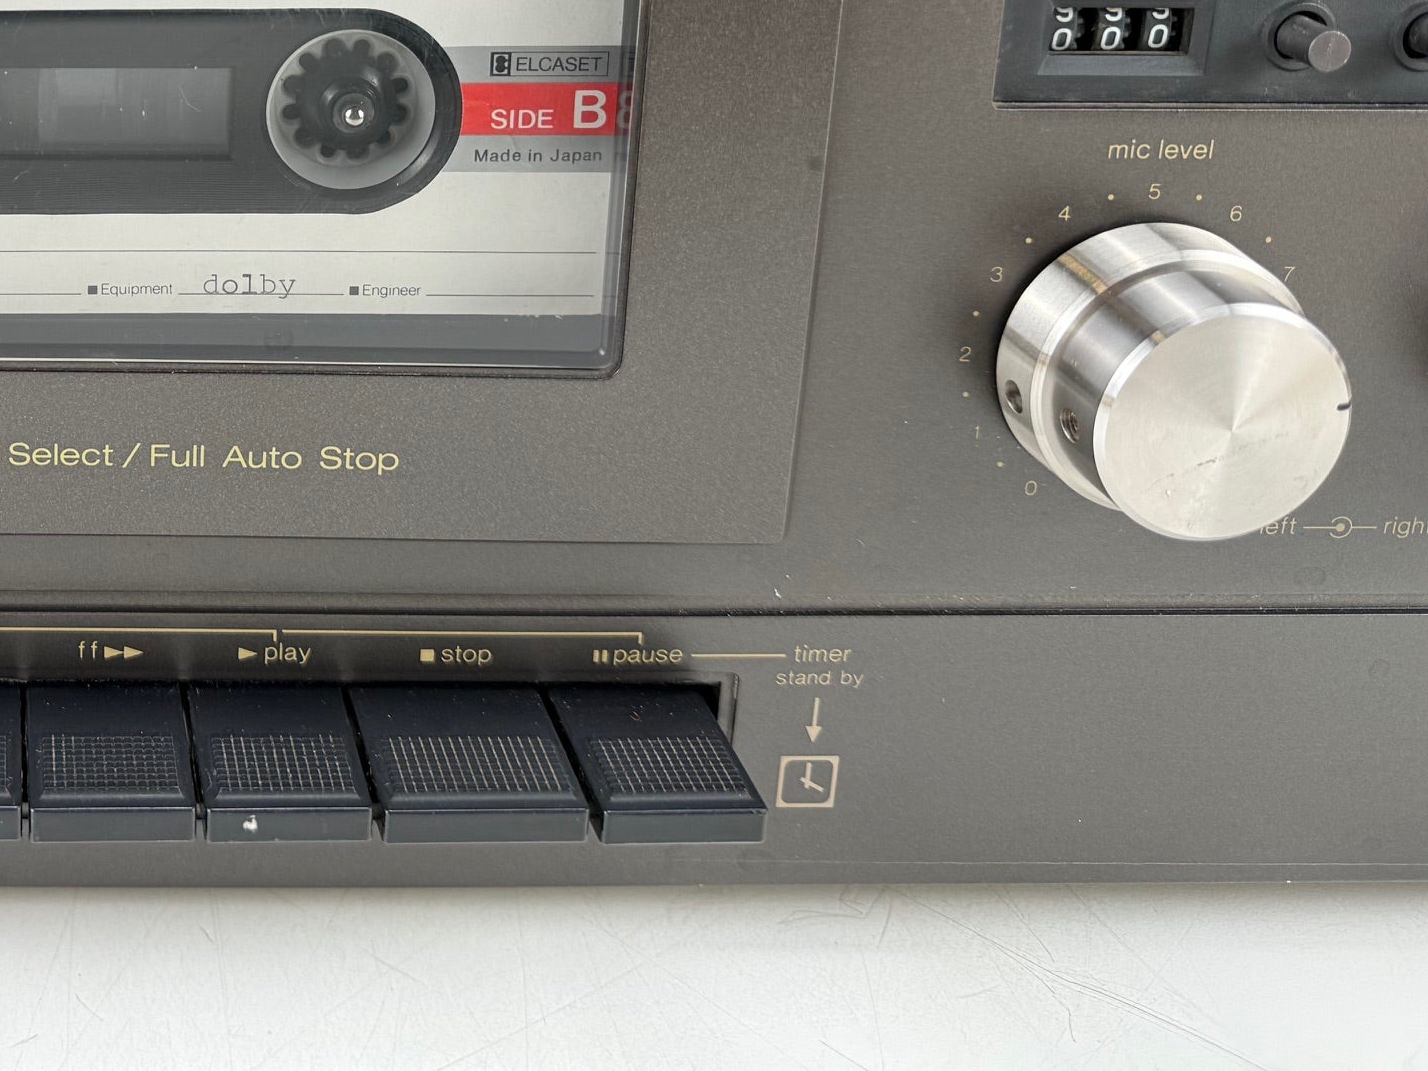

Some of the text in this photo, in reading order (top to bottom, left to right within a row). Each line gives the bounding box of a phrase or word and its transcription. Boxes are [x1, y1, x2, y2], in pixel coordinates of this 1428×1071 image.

[515, 56, 603, 72] ELCASET
[490, 89, 608, 130] SIDE B
[473, 148, 603, 166] Made in Japan
[1107, 139, 1215, 160] mic level
[1147, 182, 1162, 200] 5
[1057, 204, 1072, 222] 4
[1228, 204, 1243, 222] 6
[988, 265, 1004, 284] 3
[1283, 265, 1296, 283] 7
[100, 282, 174, 298] Equipment
[202, 273, 297, 300] dolby
[361, 283, 422, 299] Engineer
[958, 345, 973, 363] 2
[221, 444, 303, 470] Auto
[318, 444, 401, 475] Stop
[1023, 479, 1038, 497] 0
[1382, 515, 1428, 539] righ
[263, 642, 313, 666] play
[439, 643, 493, 666] stop
[611, 646, 684, 667] pause
[794, 644, 853, 664] timer
[775, 670, 865, 689] stand by
